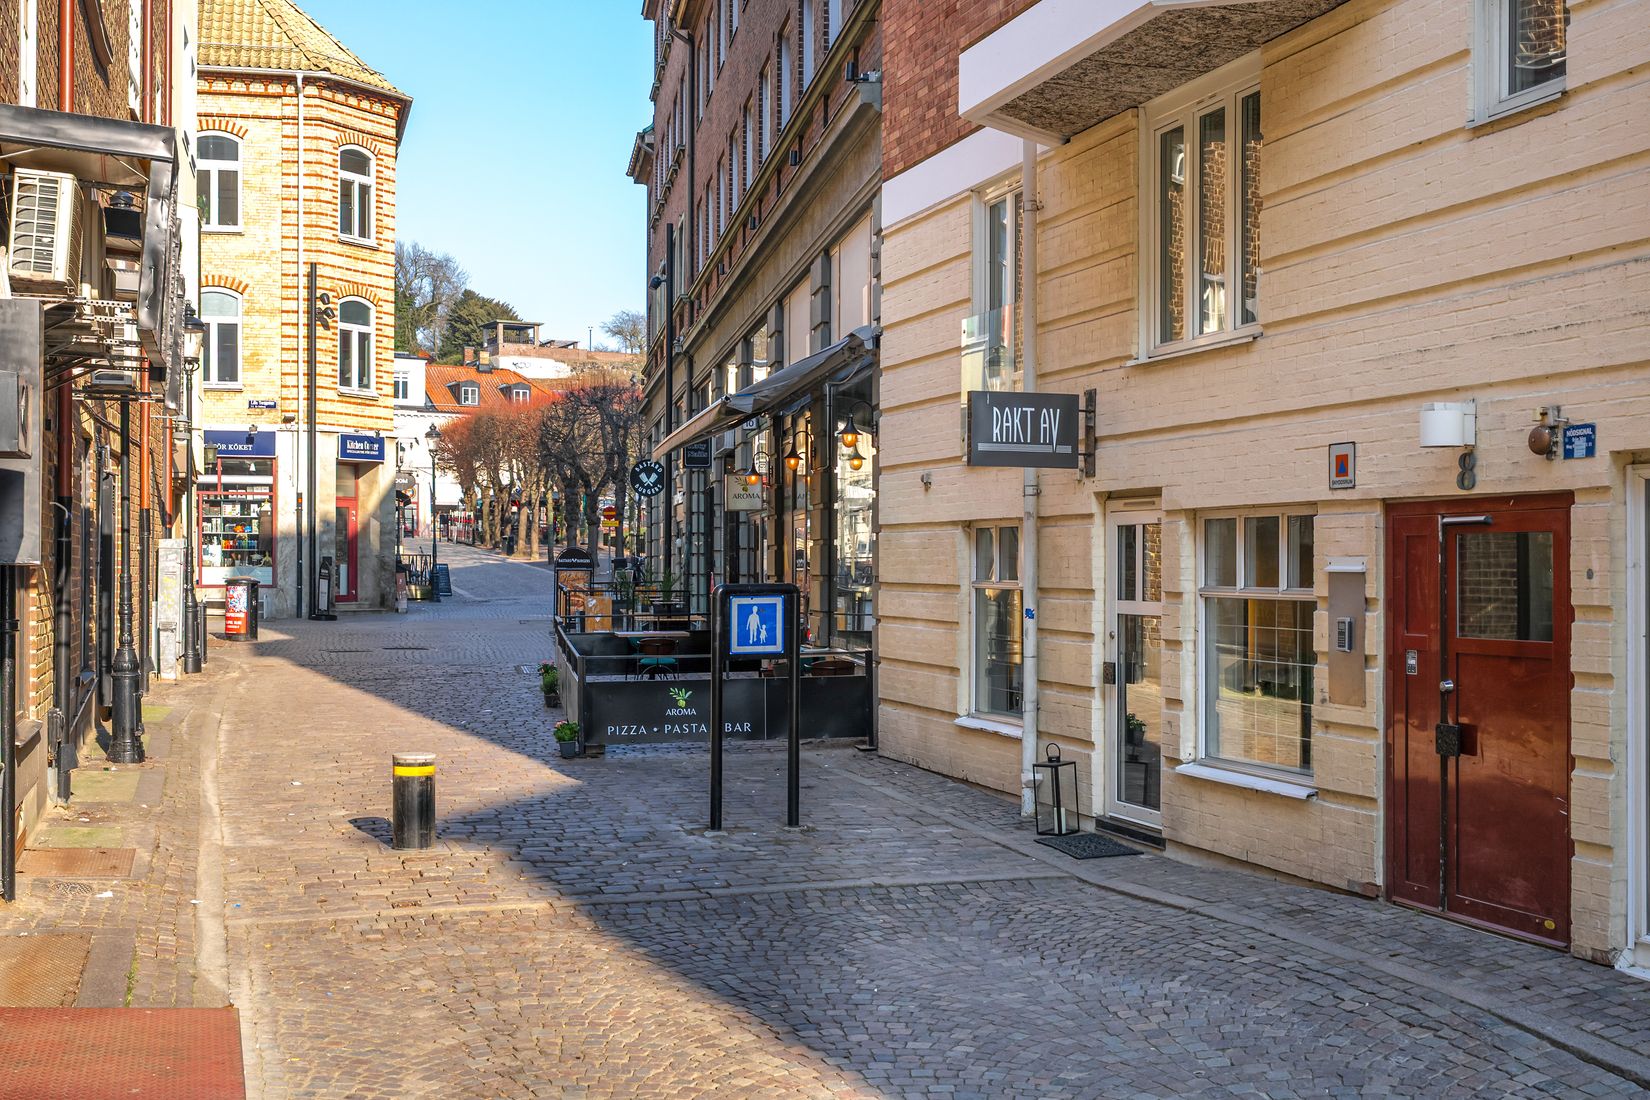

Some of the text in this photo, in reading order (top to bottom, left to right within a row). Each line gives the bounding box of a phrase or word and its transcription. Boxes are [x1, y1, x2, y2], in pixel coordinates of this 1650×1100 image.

[993, 406, 1060, 451] RAKT AV
[228, 442, 253, 451] KÖKET
[634, 461, 663, 473] BASTARD
[1456, 452, 1476, 490] 8
[634, 483, 663, 495] BURGERS
[665, 708, 697, 716] AROMA
[607, 722, 752, 736] PIZZA PASTA BAR
